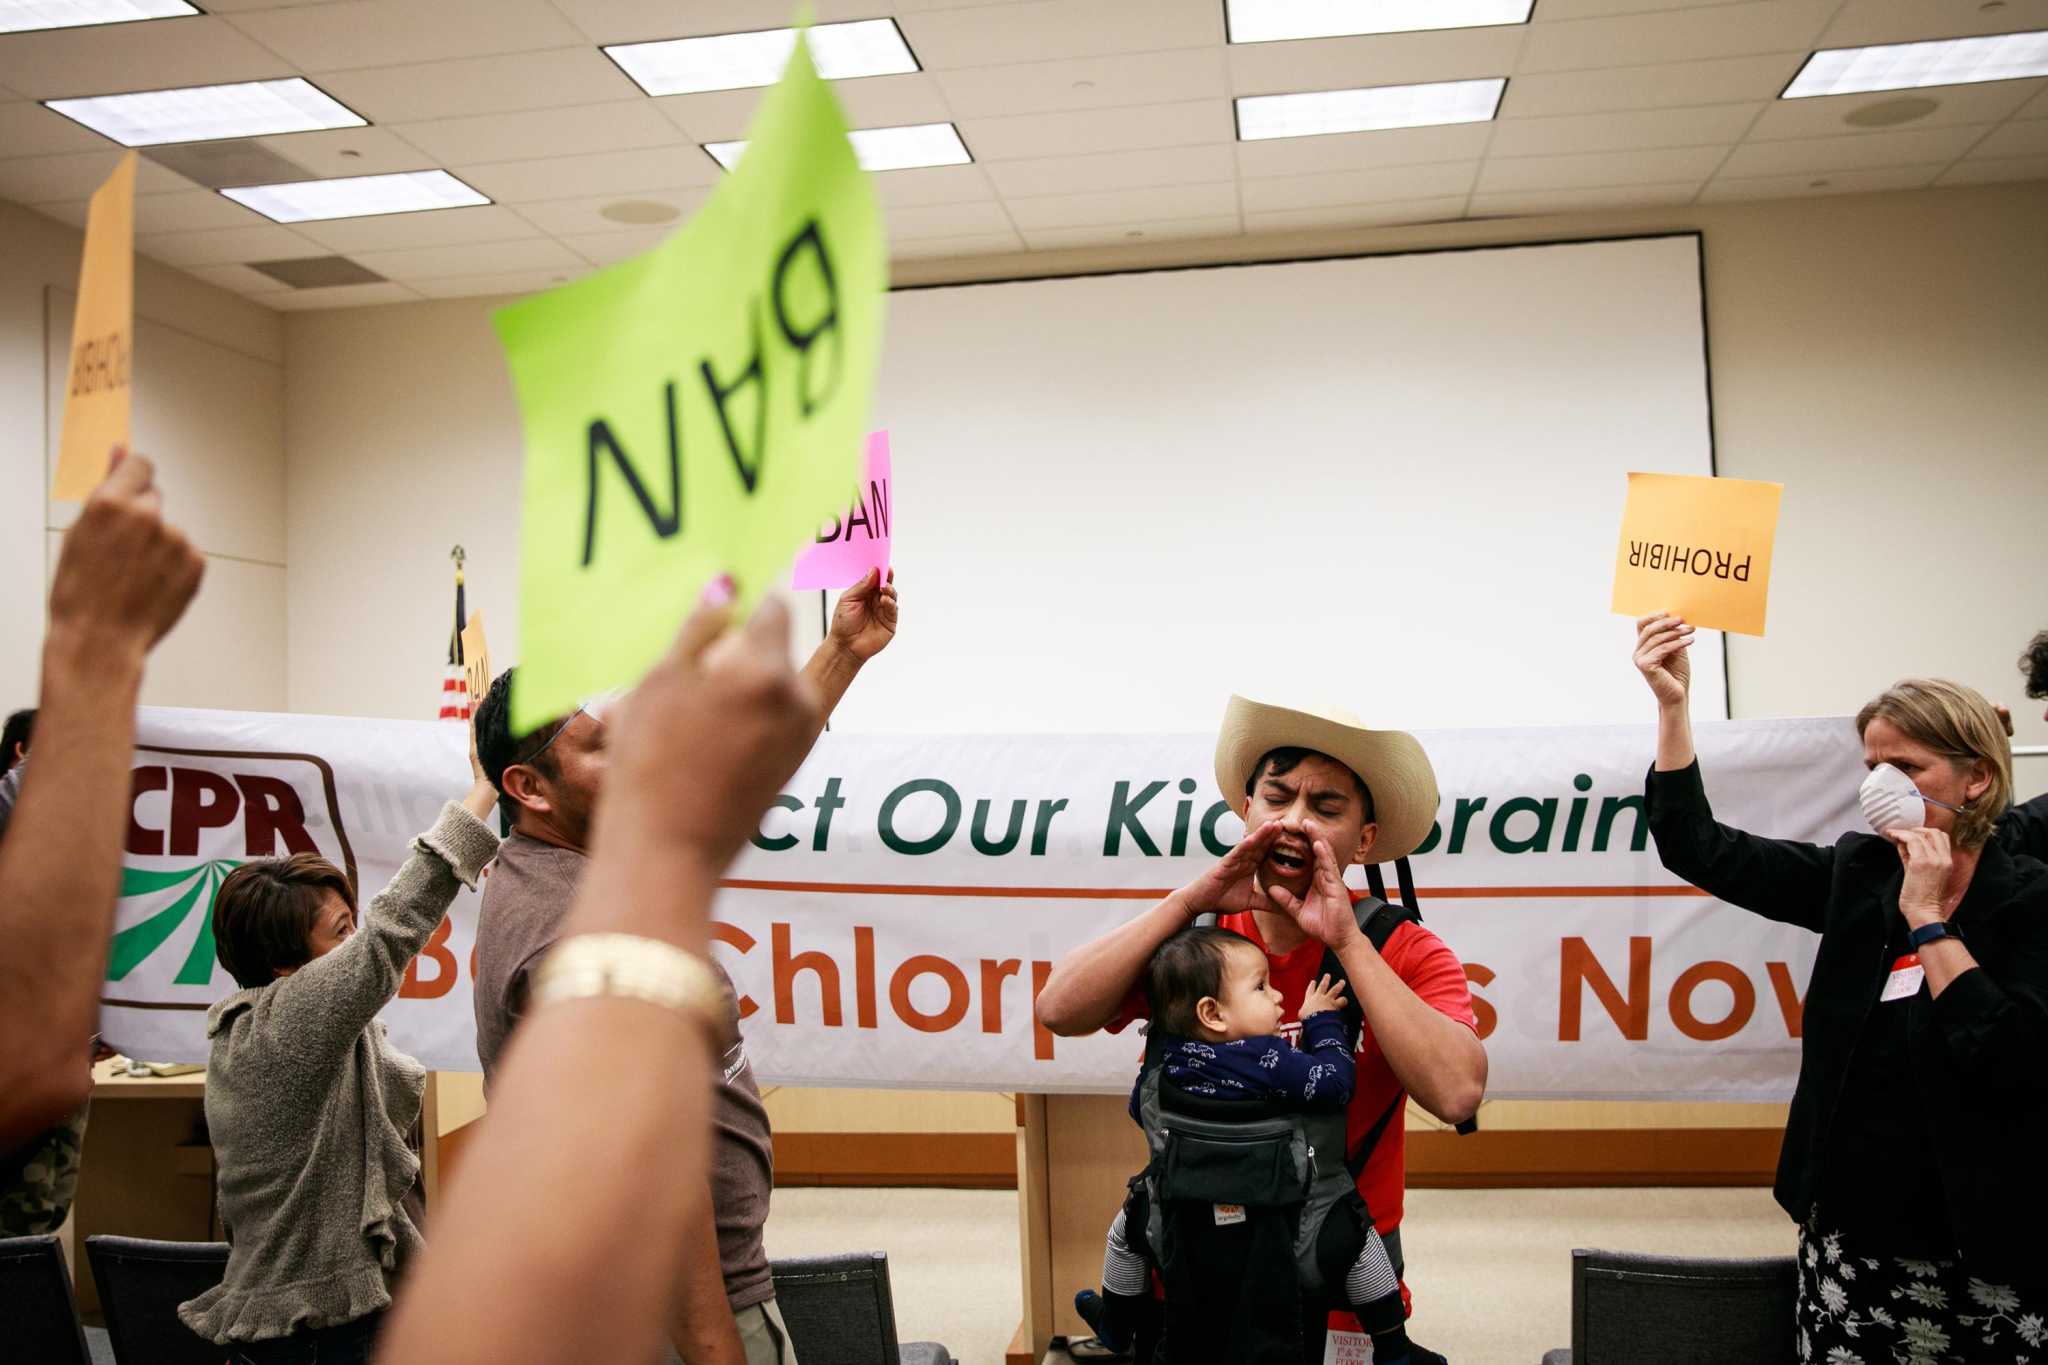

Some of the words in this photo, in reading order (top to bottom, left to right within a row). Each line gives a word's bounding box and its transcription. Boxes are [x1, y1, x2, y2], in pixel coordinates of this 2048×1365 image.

[581, 218, 844, 568] BAN
[1629, 541, 1752, 582] PROHIBIR
[127, 766, 322, 857] CPR
[877, 778, 1069, 856] Our
